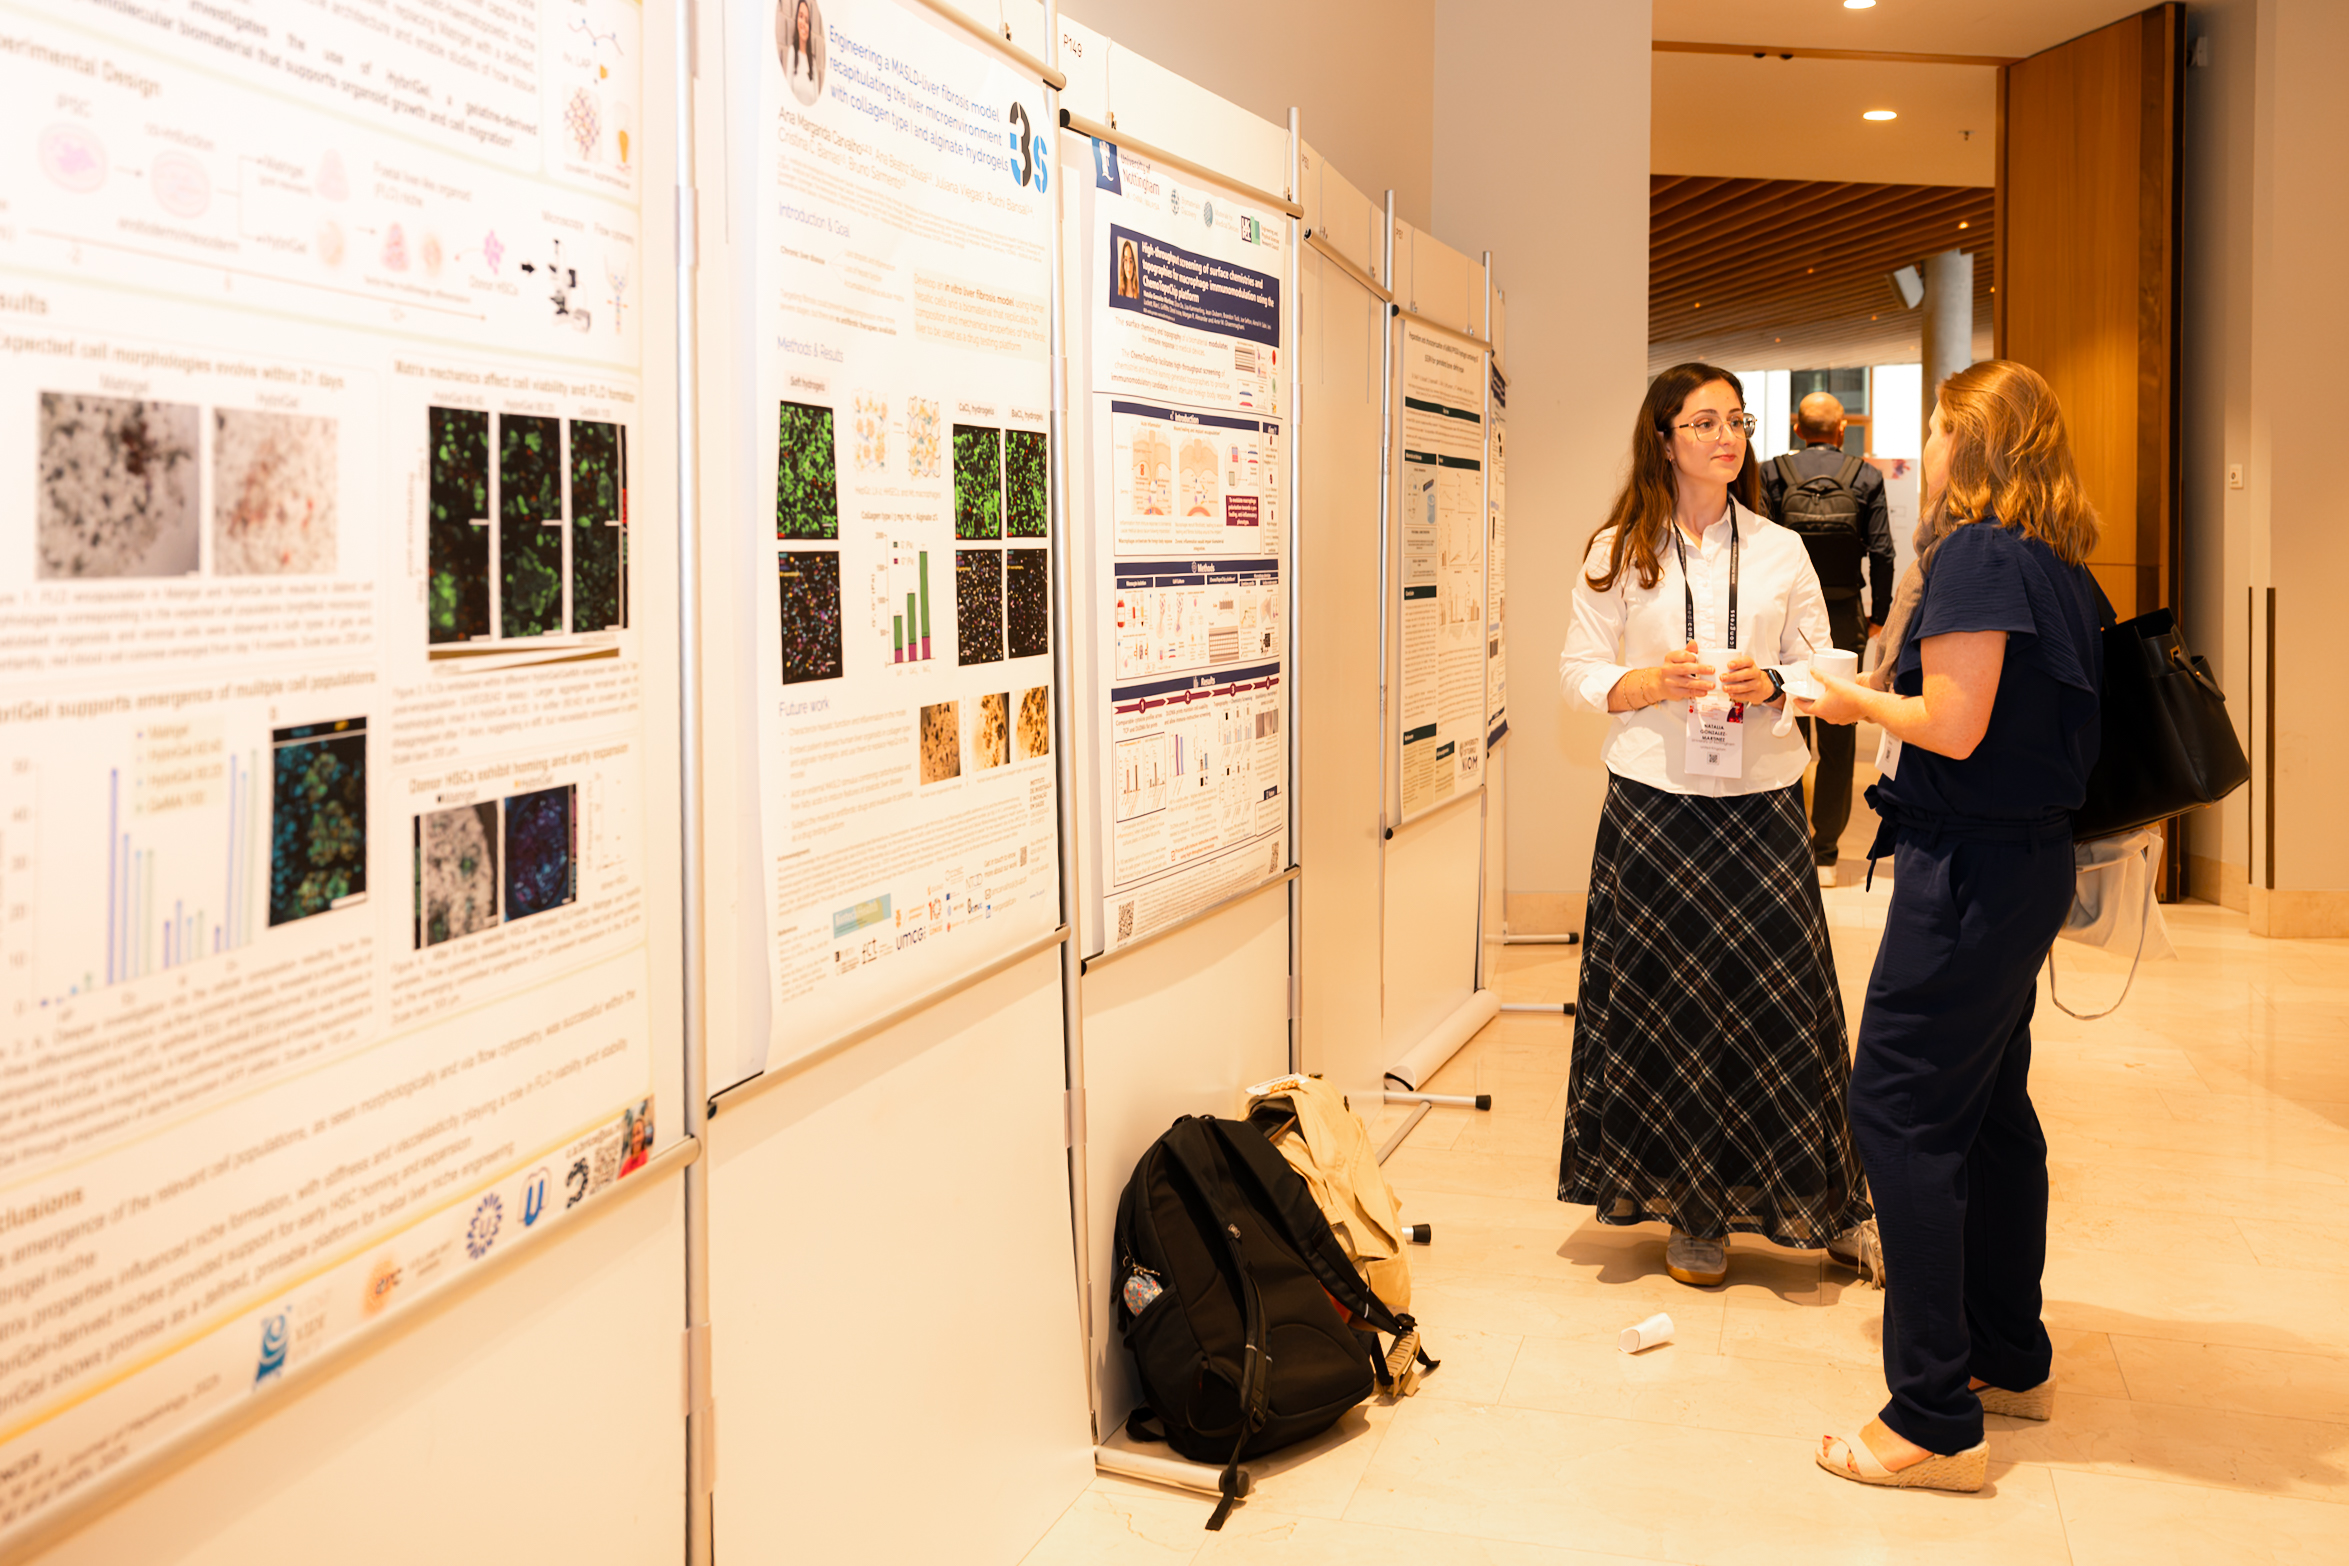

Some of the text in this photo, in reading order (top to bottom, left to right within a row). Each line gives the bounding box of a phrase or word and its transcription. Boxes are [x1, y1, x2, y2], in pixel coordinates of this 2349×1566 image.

[1063, 34, 1082, 58] P149
[829, 24, 1000, 122] Engineering a MASLD-liver fibrosis model
[829, 56, 1002, 146] recapitulating the liver microenvironment
[778, 105, 796, 126] Ana
[797, 112, 831, 142] Margarida
[829, 84, 1008, 171] with collagen type and alginate hydrogels
[1121, 154, 1145, 174] University
[1123, 168, 1160, 196] Nottingham
[779, 201, 825, 233] Introduction
[1142, 241, 1263, 289] High-throughput screening of surface chemistries and
[1142, 259, 1172, 278] topographies
[1210, 280, 1256, 302] immunomodulation
[1257, 294, 1267, 307] using
[1142, 275, 1199, 302] ChemoTopoChip platform
[777, 336, 811, 358] Methods
[1175, 412, 1199, 424] Introduction
[779, 701, 808, 717] Future
